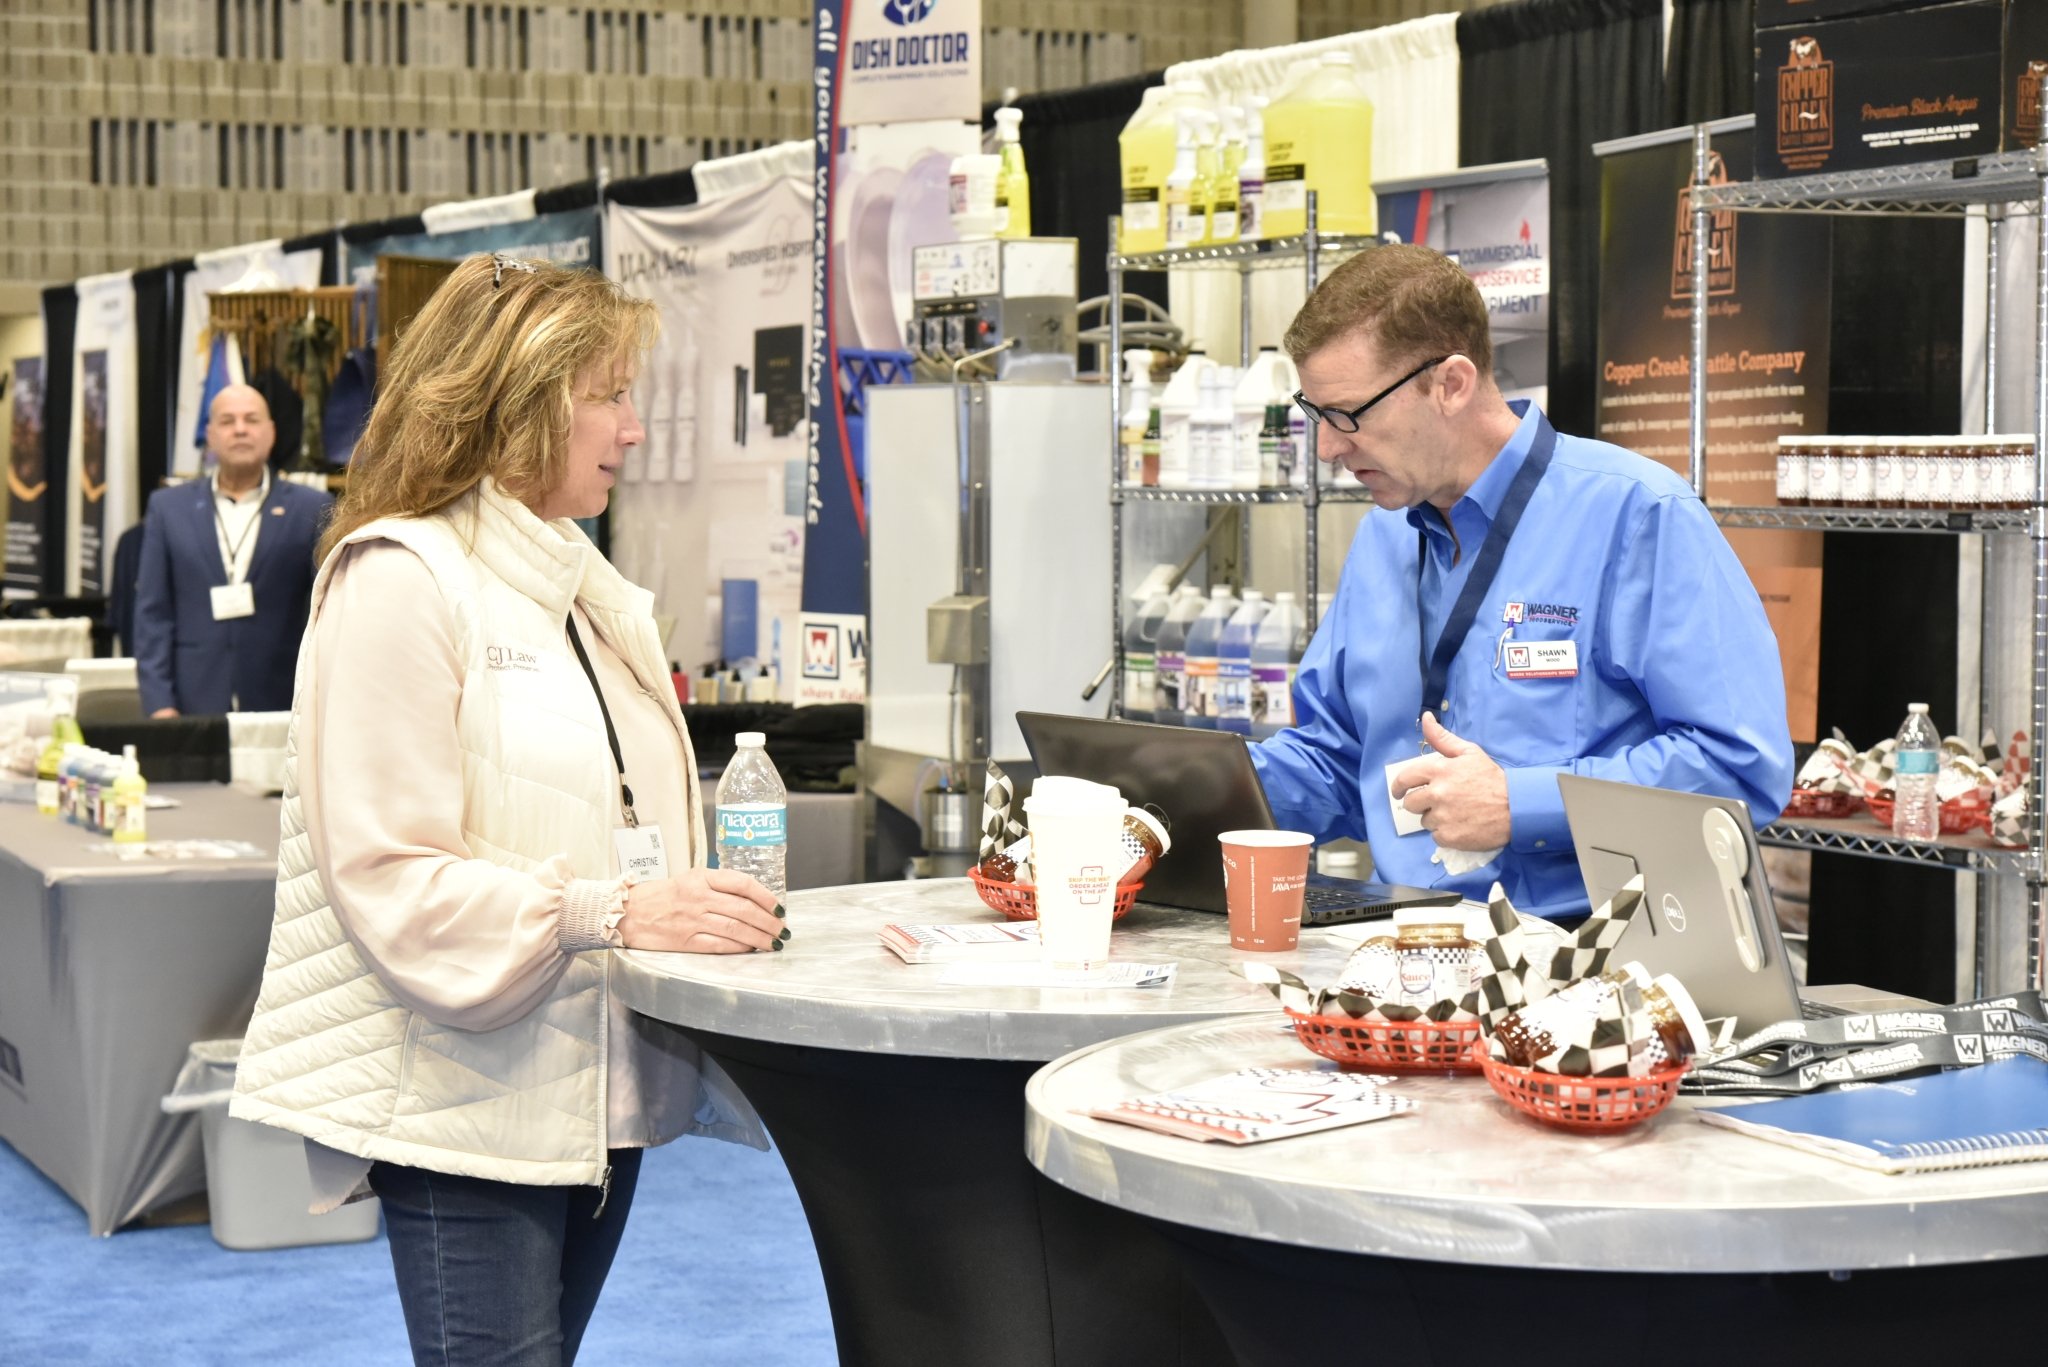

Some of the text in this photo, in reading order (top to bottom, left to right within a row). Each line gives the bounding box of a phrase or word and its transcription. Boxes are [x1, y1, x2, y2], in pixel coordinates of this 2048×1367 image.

[853, 32, 968, 70] DISH DOCTOR
[1782, 98, 1828, 133] CREEK
[1462, 243, 1542, 265] COMMERCIAL
[807, 8, 838, 525] all your warewashing needs
[1604, 350, 1806, 386] Copper Creek attle Company
[1527, 603, 1578, 621] WAGNER
[1537, 649, 1568, 657] SHAWN
[721, 812, 780, 830] niagara
[628, 856, 660, 868] CHRISTINE
[1271, 882, 1290, 893] JAVA
[1875, 1012, 1948, 1032] WAGNER
[1848, 1043, 1924, 1070] WAGNER
[1983, 1035, 2048, 1058] WAGNER
